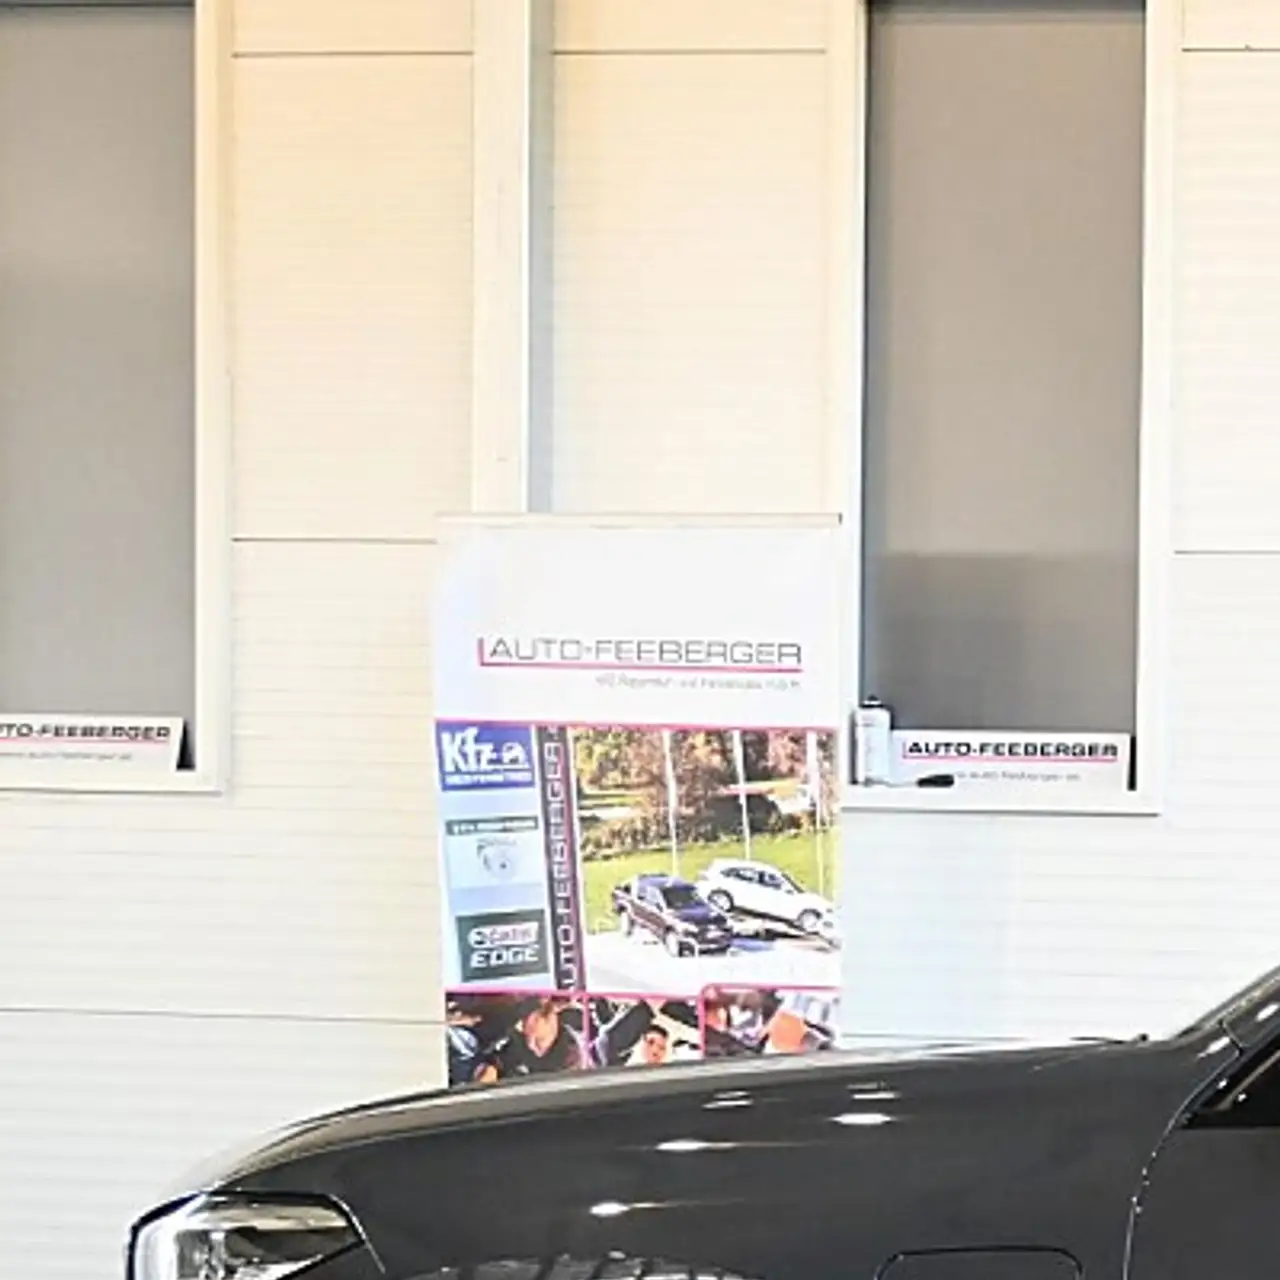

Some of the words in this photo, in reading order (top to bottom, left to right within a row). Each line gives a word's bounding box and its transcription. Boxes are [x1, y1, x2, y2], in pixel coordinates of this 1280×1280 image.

[490, 637, 802, 664] AUTO-FEEBERGER
[908, 741, 1118, 757] AUTO-FEEBERGER
[470, 944, 539, 968] EDGE
